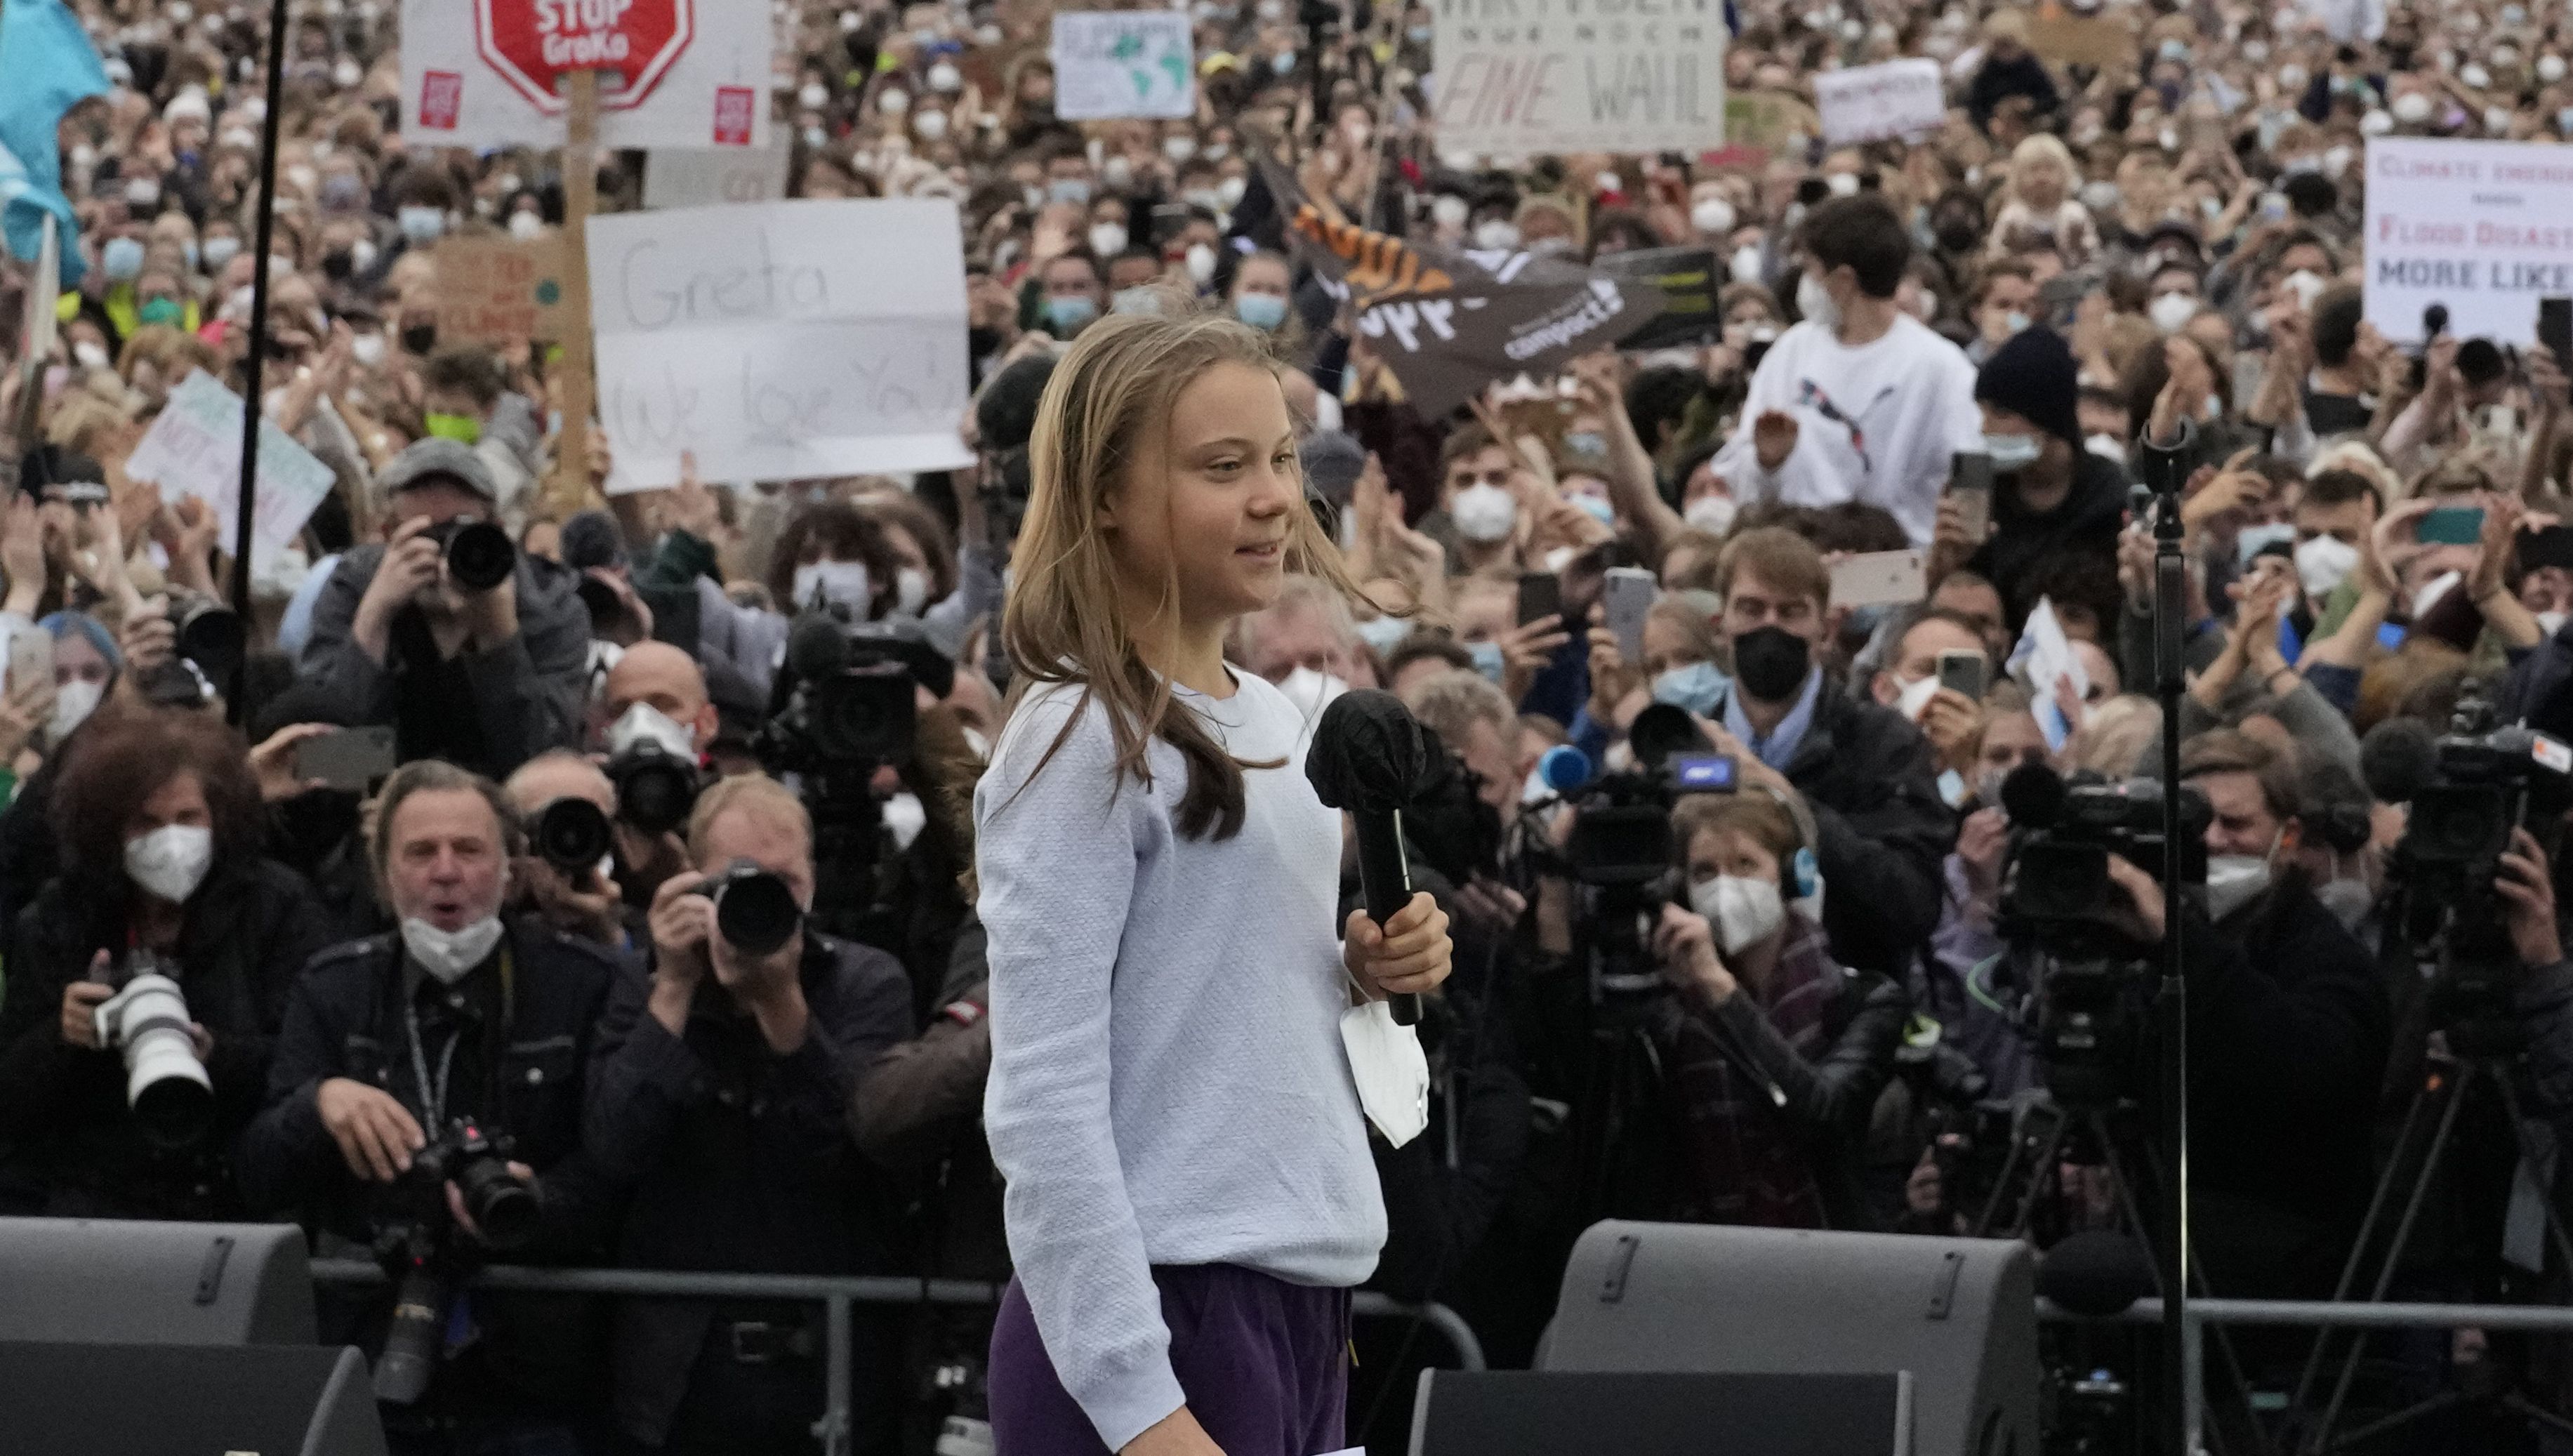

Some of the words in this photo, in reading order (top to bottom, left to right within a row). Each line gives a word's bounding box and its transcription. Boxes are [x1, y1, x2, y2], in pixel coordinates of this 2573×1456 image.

[535, 0, 632, 32] STOP
[543, 32, 630, 65] GroKo
[1585, 52, 1708, 124] WAHL
[621, 223, 830, 332] Greta
[2377, 258, 2477, 289] MORE
[2490, 261, 2570, 291] LIKE
